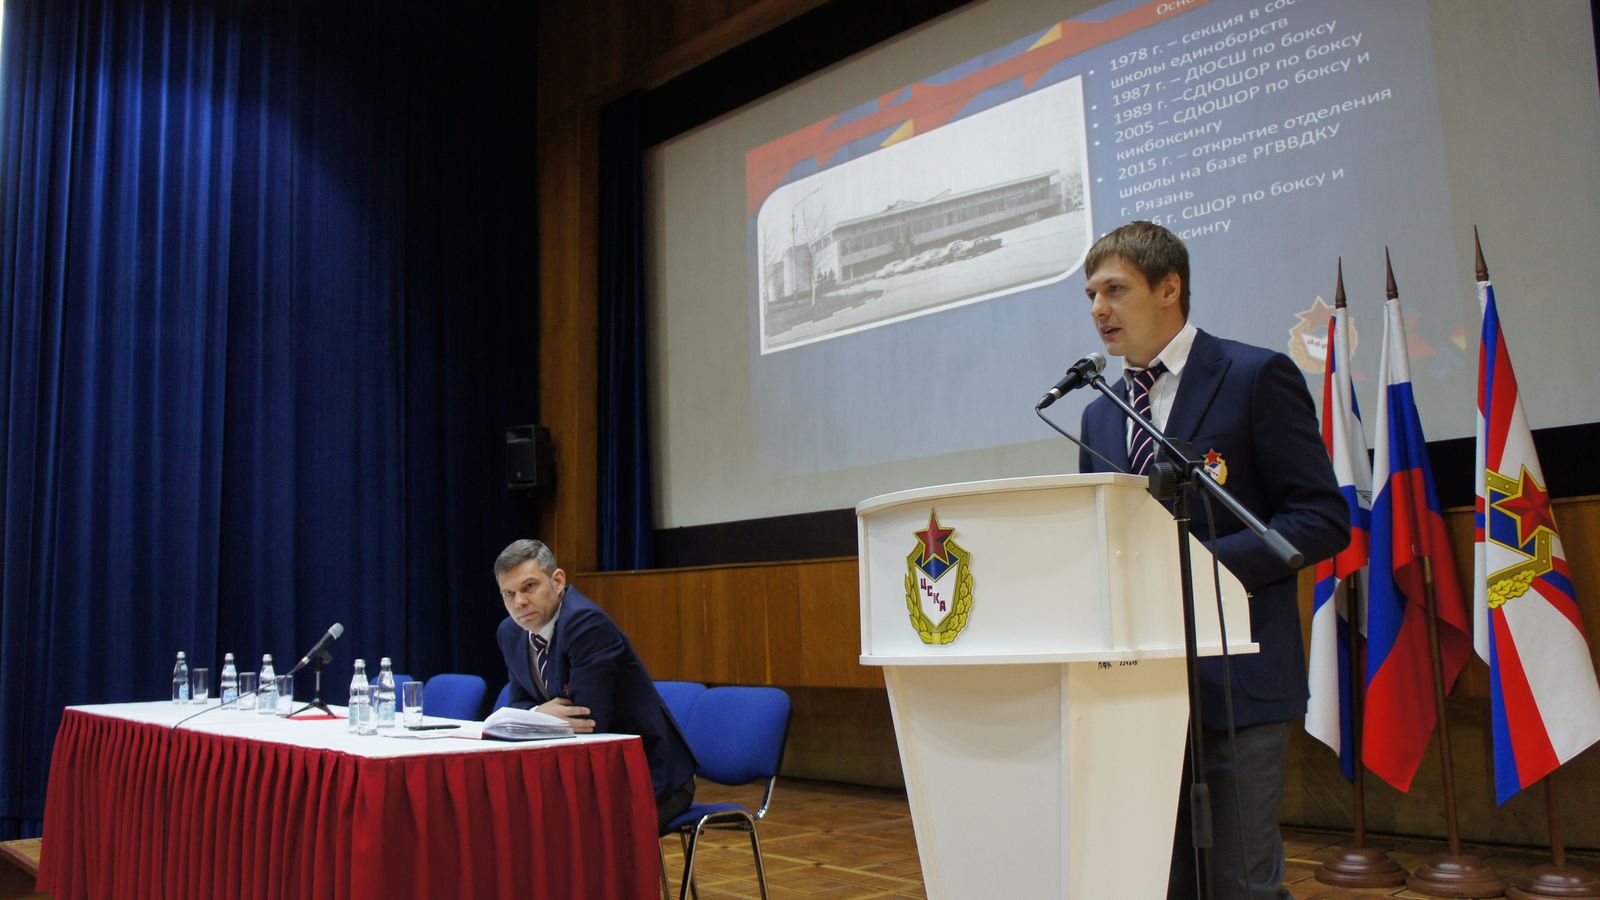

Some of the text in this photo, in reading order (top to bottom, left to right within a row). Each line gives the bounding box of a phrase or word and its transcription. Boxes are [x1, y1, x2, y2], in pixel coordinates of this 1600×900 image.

[1111, 48, 1148, 71] 1978
[1152, 45, 1163, 55] г.
[1182, 14, 1244, 44] секция
[1249, 8, 1259, 19] в
[1265, 0, 1296, 13] сос
[1111, 17, 1288, 89] школы единоборств
[1112, 85, 1151, 107] 1987
[1156, 81, 1166, 91] г.
[1185, 53, 1246, 84] ДЮСШ
[1253, 41, 1275, 57] по
[1280, 20, 1337, 48] боксу
[1114, 103, 1153, 125] 1989
[1158, 99, 1168, 110] г.
[1276, 54, 1299, 69] по
[1305, 32, 1363, 60] боксу
[1115, 122, 1154, 144] 2005
[1173, 86, 1260, 123] СДЮШОР
[1266, 78, 1289, 94] по
[1295, 57, 1351, 84] боксу
[1358, 51, 1370, 63] и
[1116, 119, 1223, 161] кикбоксингу
[1119, 158, 1157, 180] 2015
[1162, 156, 1172, 165] г.
[1192, 123, 1279, 157] открытие
[1284, 87, 1392, 130] отделения
[1119, 122, 1341, 199] школы на базе РГВВДКУ
[1120, 189, 1194, 217] г. Рязань
[1167, 214, 1177, 225] г.
[1182, 194, 1237, 220] СШОР
[1242, 189, 1265, 204] по
[1270, 171, 1326, 197] боксу
[1332, 167, 1344, 180] и
[920, 577, 946, 612] ЦСКА
